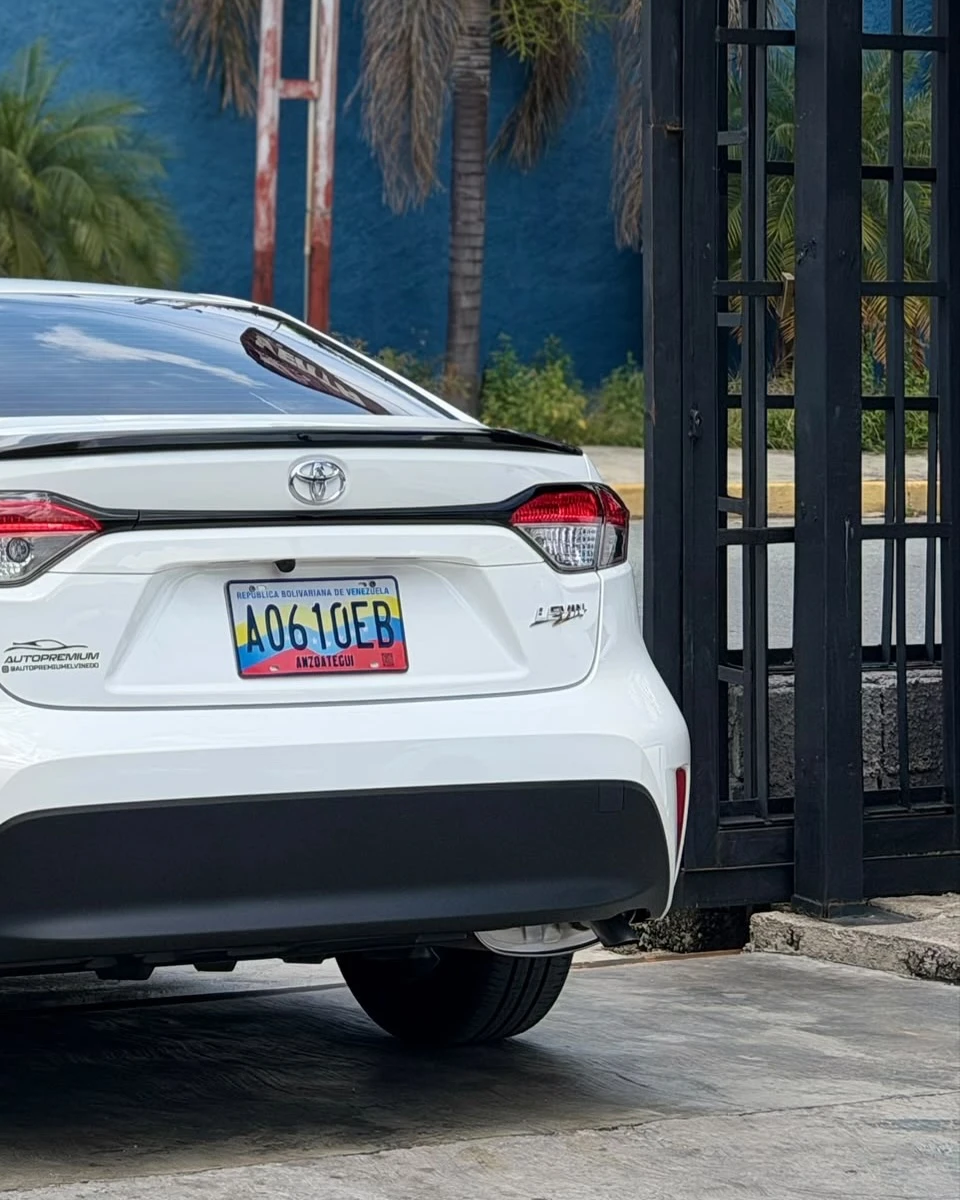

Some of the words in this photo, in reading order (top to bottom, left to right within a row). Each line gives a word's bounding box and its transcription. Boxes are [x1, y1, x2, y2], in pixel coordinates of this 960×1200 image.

[281, 588, 332, 598] BOLIVARIANA
[334, 588, 344, 596] DE
[346, 587, 390, 596] VENEZUELA
[4, 652, 100, 664] AUTOPREMIUM
[296, 655, 355, 668] ANZOATEGUI
